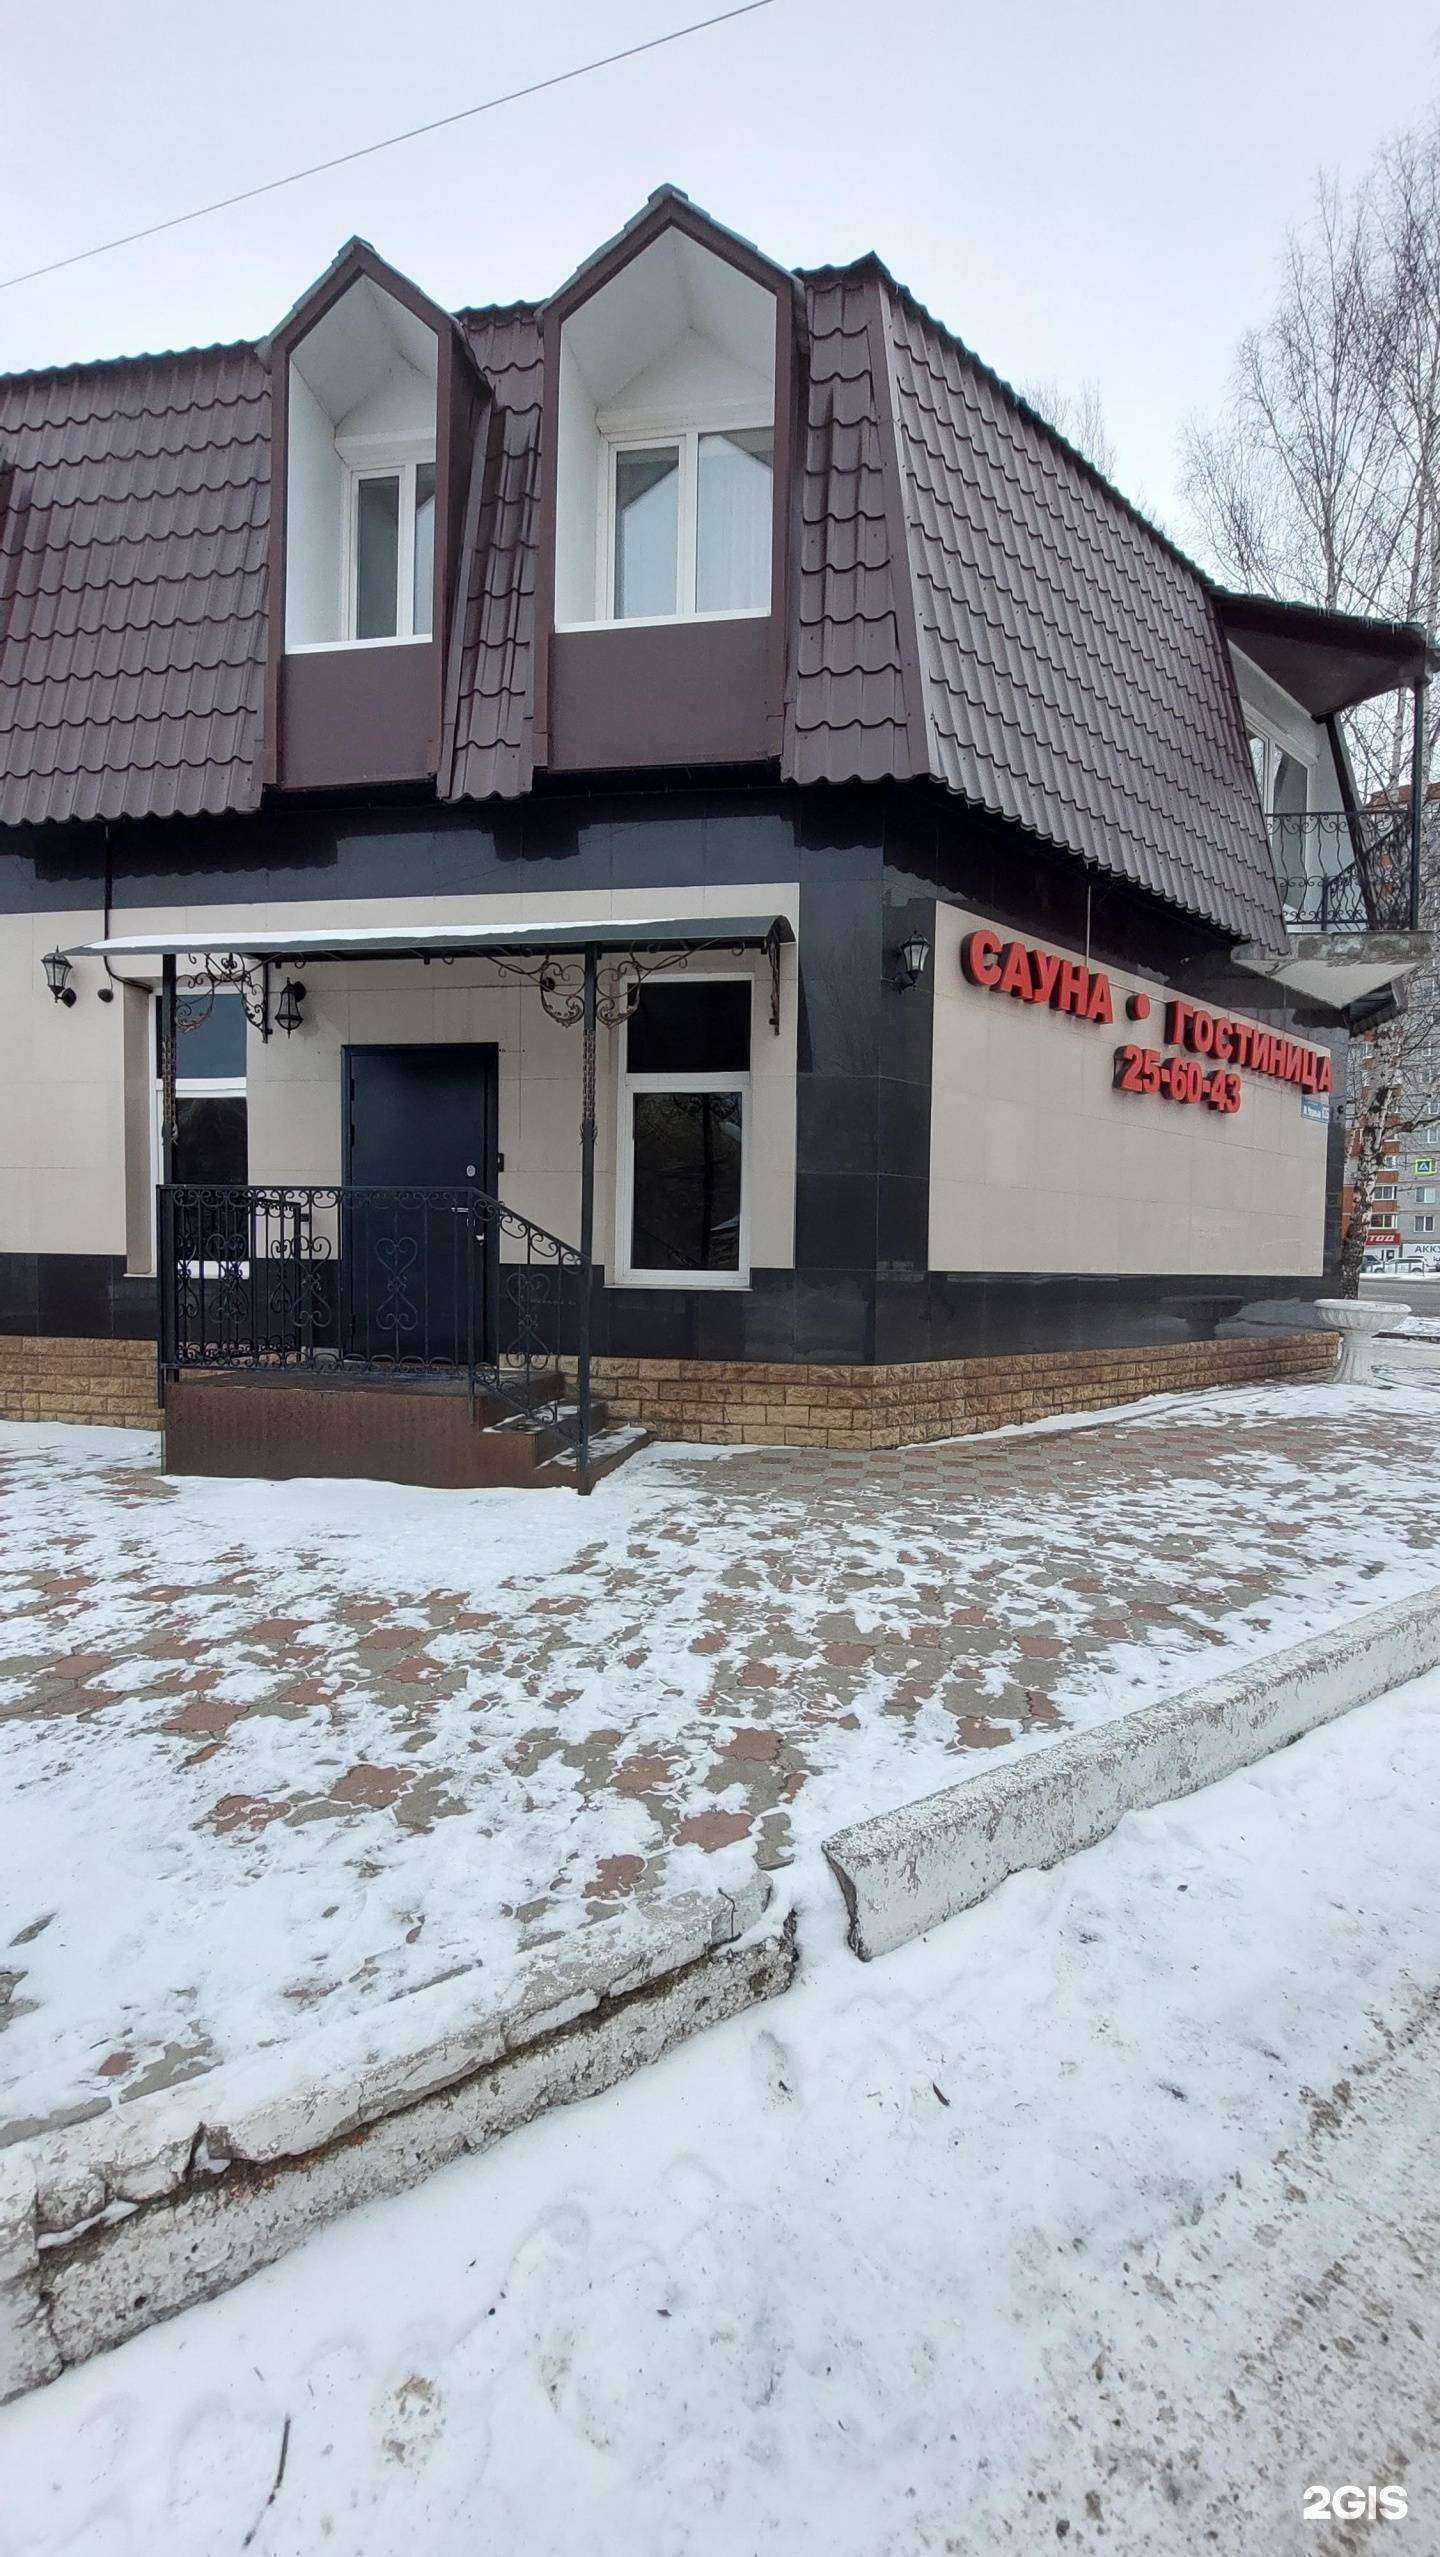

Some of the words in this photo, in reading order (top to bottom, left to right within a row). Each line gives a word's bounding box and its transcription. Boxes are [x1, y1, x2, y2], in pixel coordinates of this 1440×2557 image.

[961, 929, 1113, 1025] САУНА
[1165, 1000, 1334, 1095] ГОСТИНИЦА
[1114, 1044, 1243, 1114] 25-60-43
